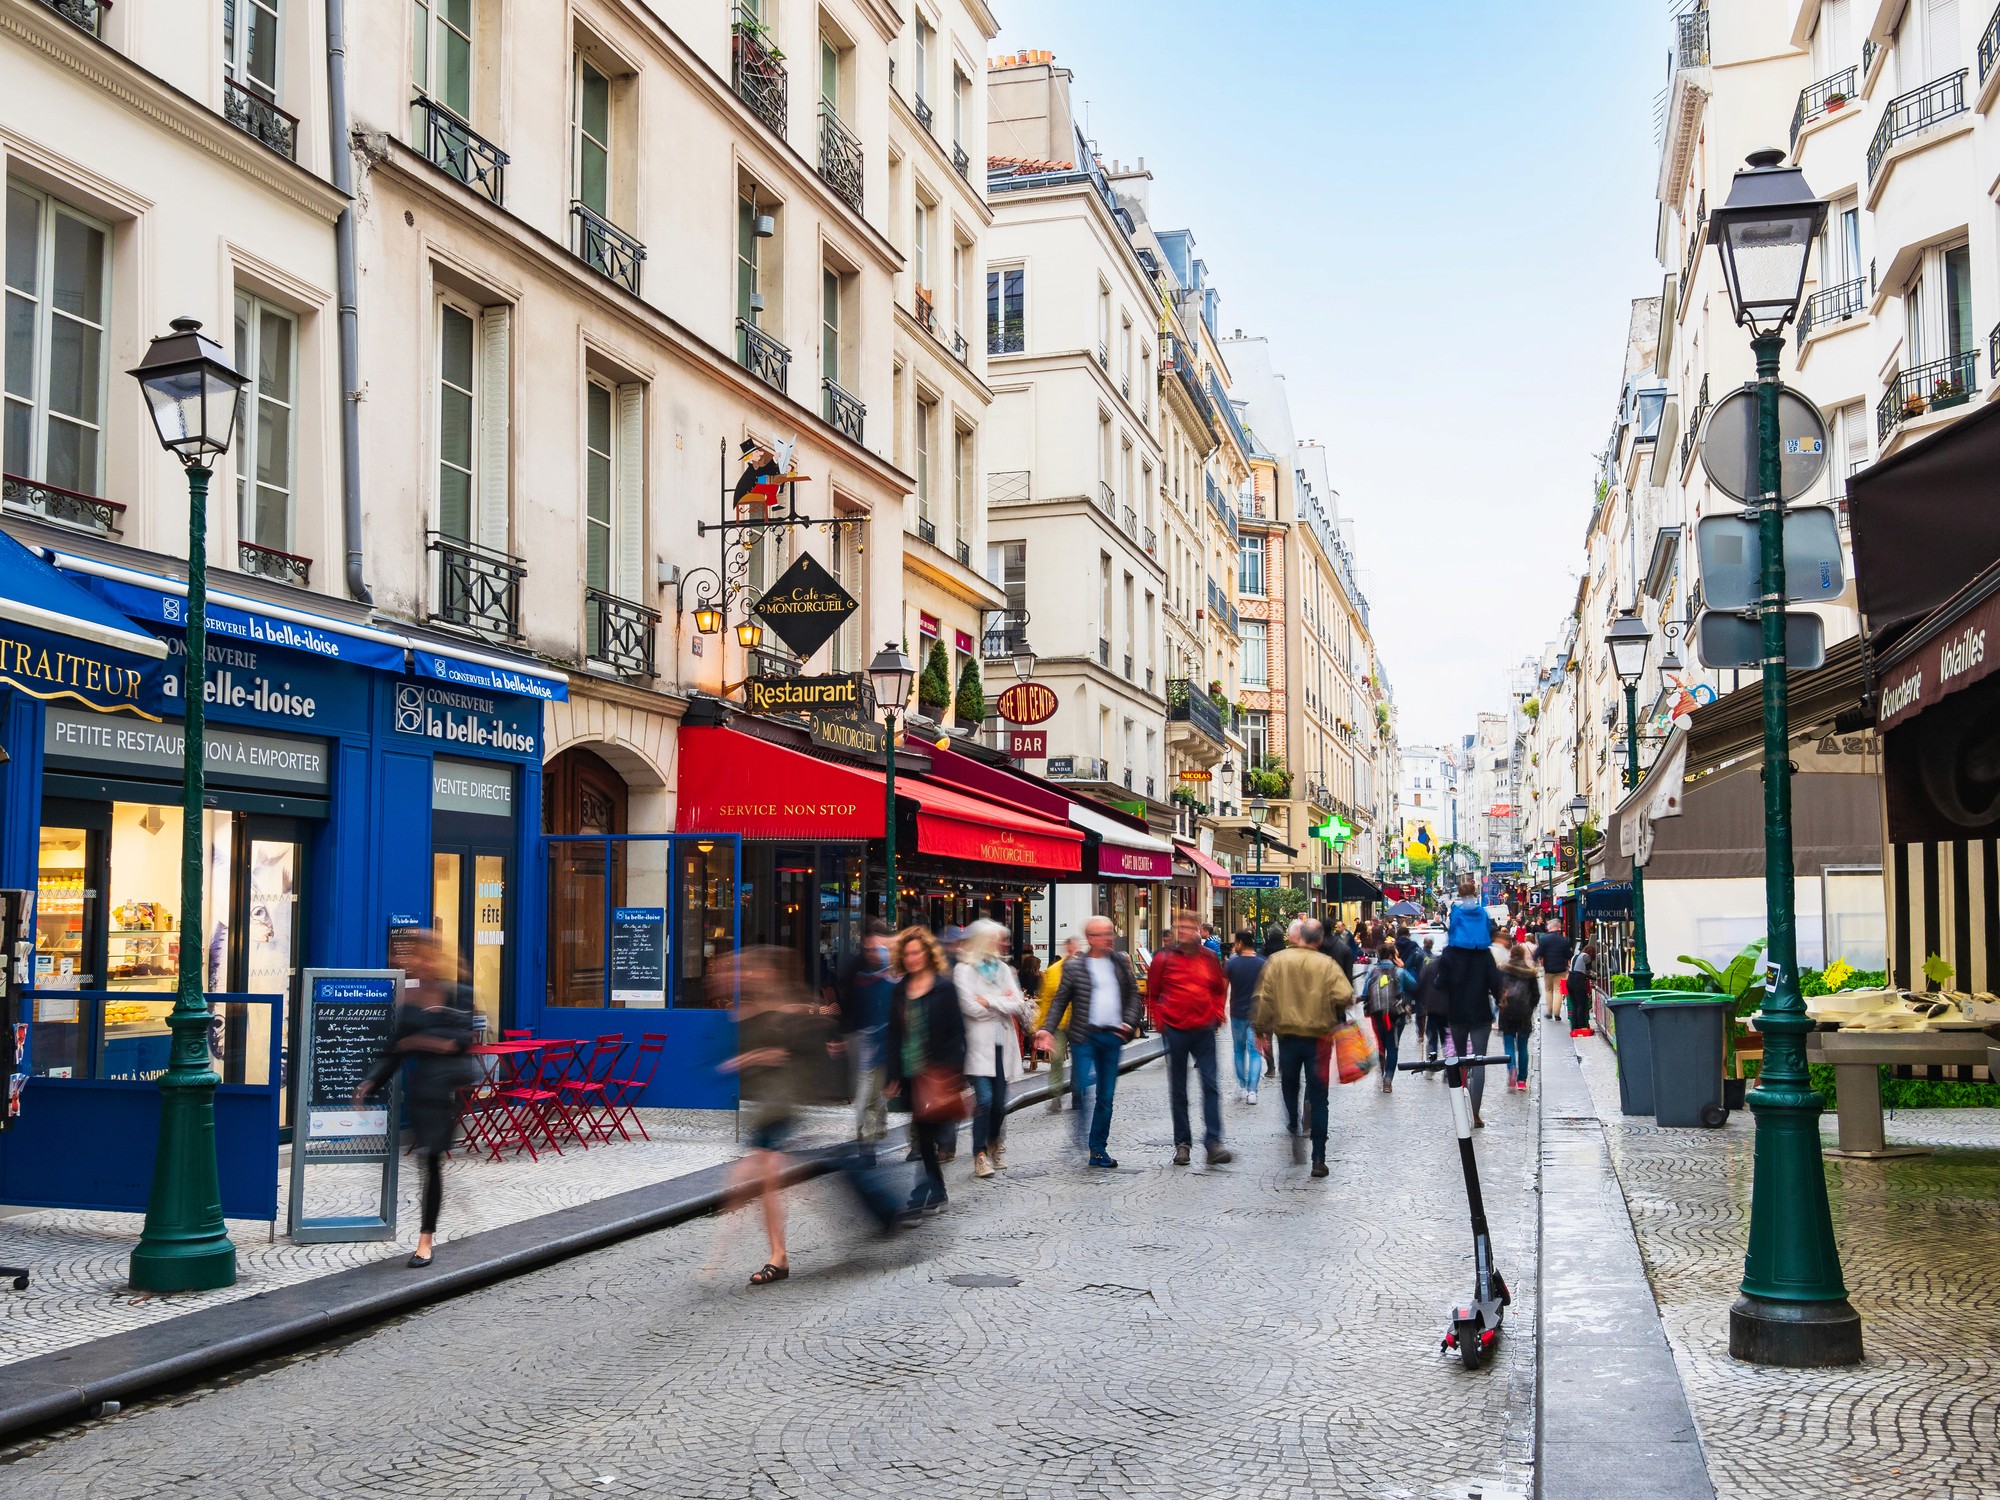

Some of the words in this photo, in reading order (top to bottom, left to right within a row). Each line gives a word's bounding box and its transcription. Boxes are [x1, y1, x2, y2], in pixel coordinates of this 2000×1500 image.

[766, 599, 845, 614] MONTORGUEIL
[250, 617, 264, 640] la
[266, 621, 340, 656] belle-iloise
[0, 638, 142, 700] TRAITEUR
[1881, 664, 1922, 721] Boucherie
[1940, 627, 1986, 684] Volailles
[163, 673, 178, 697] a
[185, 670, 316, 719] elle-iloise
[449, 670, 491, 687] CONSERVERIE
[491, 671, 503, 688] la
[503, 673, 553, 698] belle-iloise
[754, 680, 857, 709] Restaurant
[427, 688, 494, 714] CONSERVERIE
[1016, 686, 1028, 722] DU
[1029, 686, 1055, 721] CENTRE
[426, 708, 442, 738] la
[446, 711, 535, 753] belle-iloise
[822, 721, 877, 753] MONTORGUEIL
[56, 722, 112, 747] PETITE
[117, 731, 232, 764] RESTAURION
[236, 742, 247, 763] À
[250, 747, 320, 772] EMPORTER
[1014, 738, 1042, 751] BAR
[434, 778, 468, 796] VENTE
[470, 782, 511, 801] DIRECTE
[1181, 772, 1211, 781] NICOLAS
[719, 804, 777, 817] SERVICE
[784, 804, 816, 816] NON
[819, 804, 857, 816] STOP
[981, 844, 1037, 864] MONTORGUEIL
[482, 904, 499, 923] FÊTE
[478, 930, 504, 945] MAMAN
[334, 990, 342, 998] la
[343, 989, 388, 998] belle-iloise
[338, 1007, 345, 1016] À
